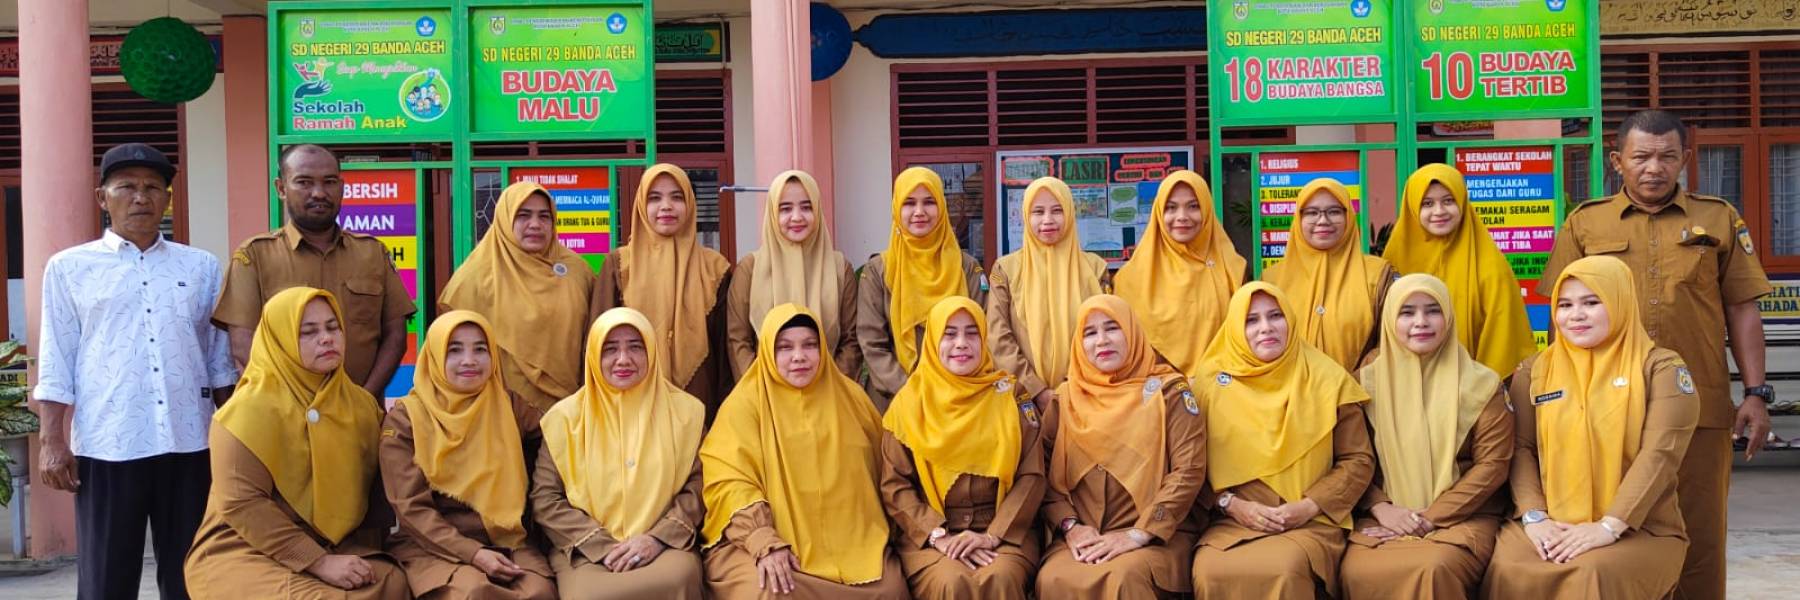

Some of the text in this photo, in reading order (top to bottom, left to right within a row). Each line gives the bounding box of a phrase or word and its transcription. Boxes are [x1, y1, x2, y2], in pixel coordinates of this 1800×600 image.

[1226, 28, 1381, 46] SD NEGERI 29 BANDA ACEH
[1421, 22, 1575, 41] SD NEGERI 29 BANDA ACEH
[292, 40, 446, 56] SD NEGERI 29 BANDA ACEH
[483, 44, 636, 61] SD NEGERI 29 BANDA ACEH
[1267, 55, 1382, 80] KARAKTER
[1479, 51, 1576, 73] BUDAYA
[502, 69, 615, 94] BUDAYA
[1224, 57, 1262, 102] 18
[1421, 51, 1475, 100] 10
[1267, 81, 1385, 99] BUDAYA BANGSA
[1479, 74, 1567, 97] TERTIB
[293, 100, 364, 114] Sekolah
[518, 97, 599, 121] MALU
[293, 116, 407, 130] Ramah Anak
[1268, 158, 1298, 169] RELIGIUS
[1466, 152, 1513, 162] BERANGKAT
[1515, 150, 1552, 161] SEKOLAH
[1466, 162, 1521, 172] TEPAT WAKTU
[1269, 175, 1291, 185] JUJUR
[1467, 178, 1528, 188] MENGERJAKAN
[343, 183, 398, 199] BERSIH
[1269, 189, 1300, 199] TOLERAN
[1467, 188, 1542, 198] TUGAS DARI GURU
[1475, 205, 1550, 215] EMAKAI SERAGAM
